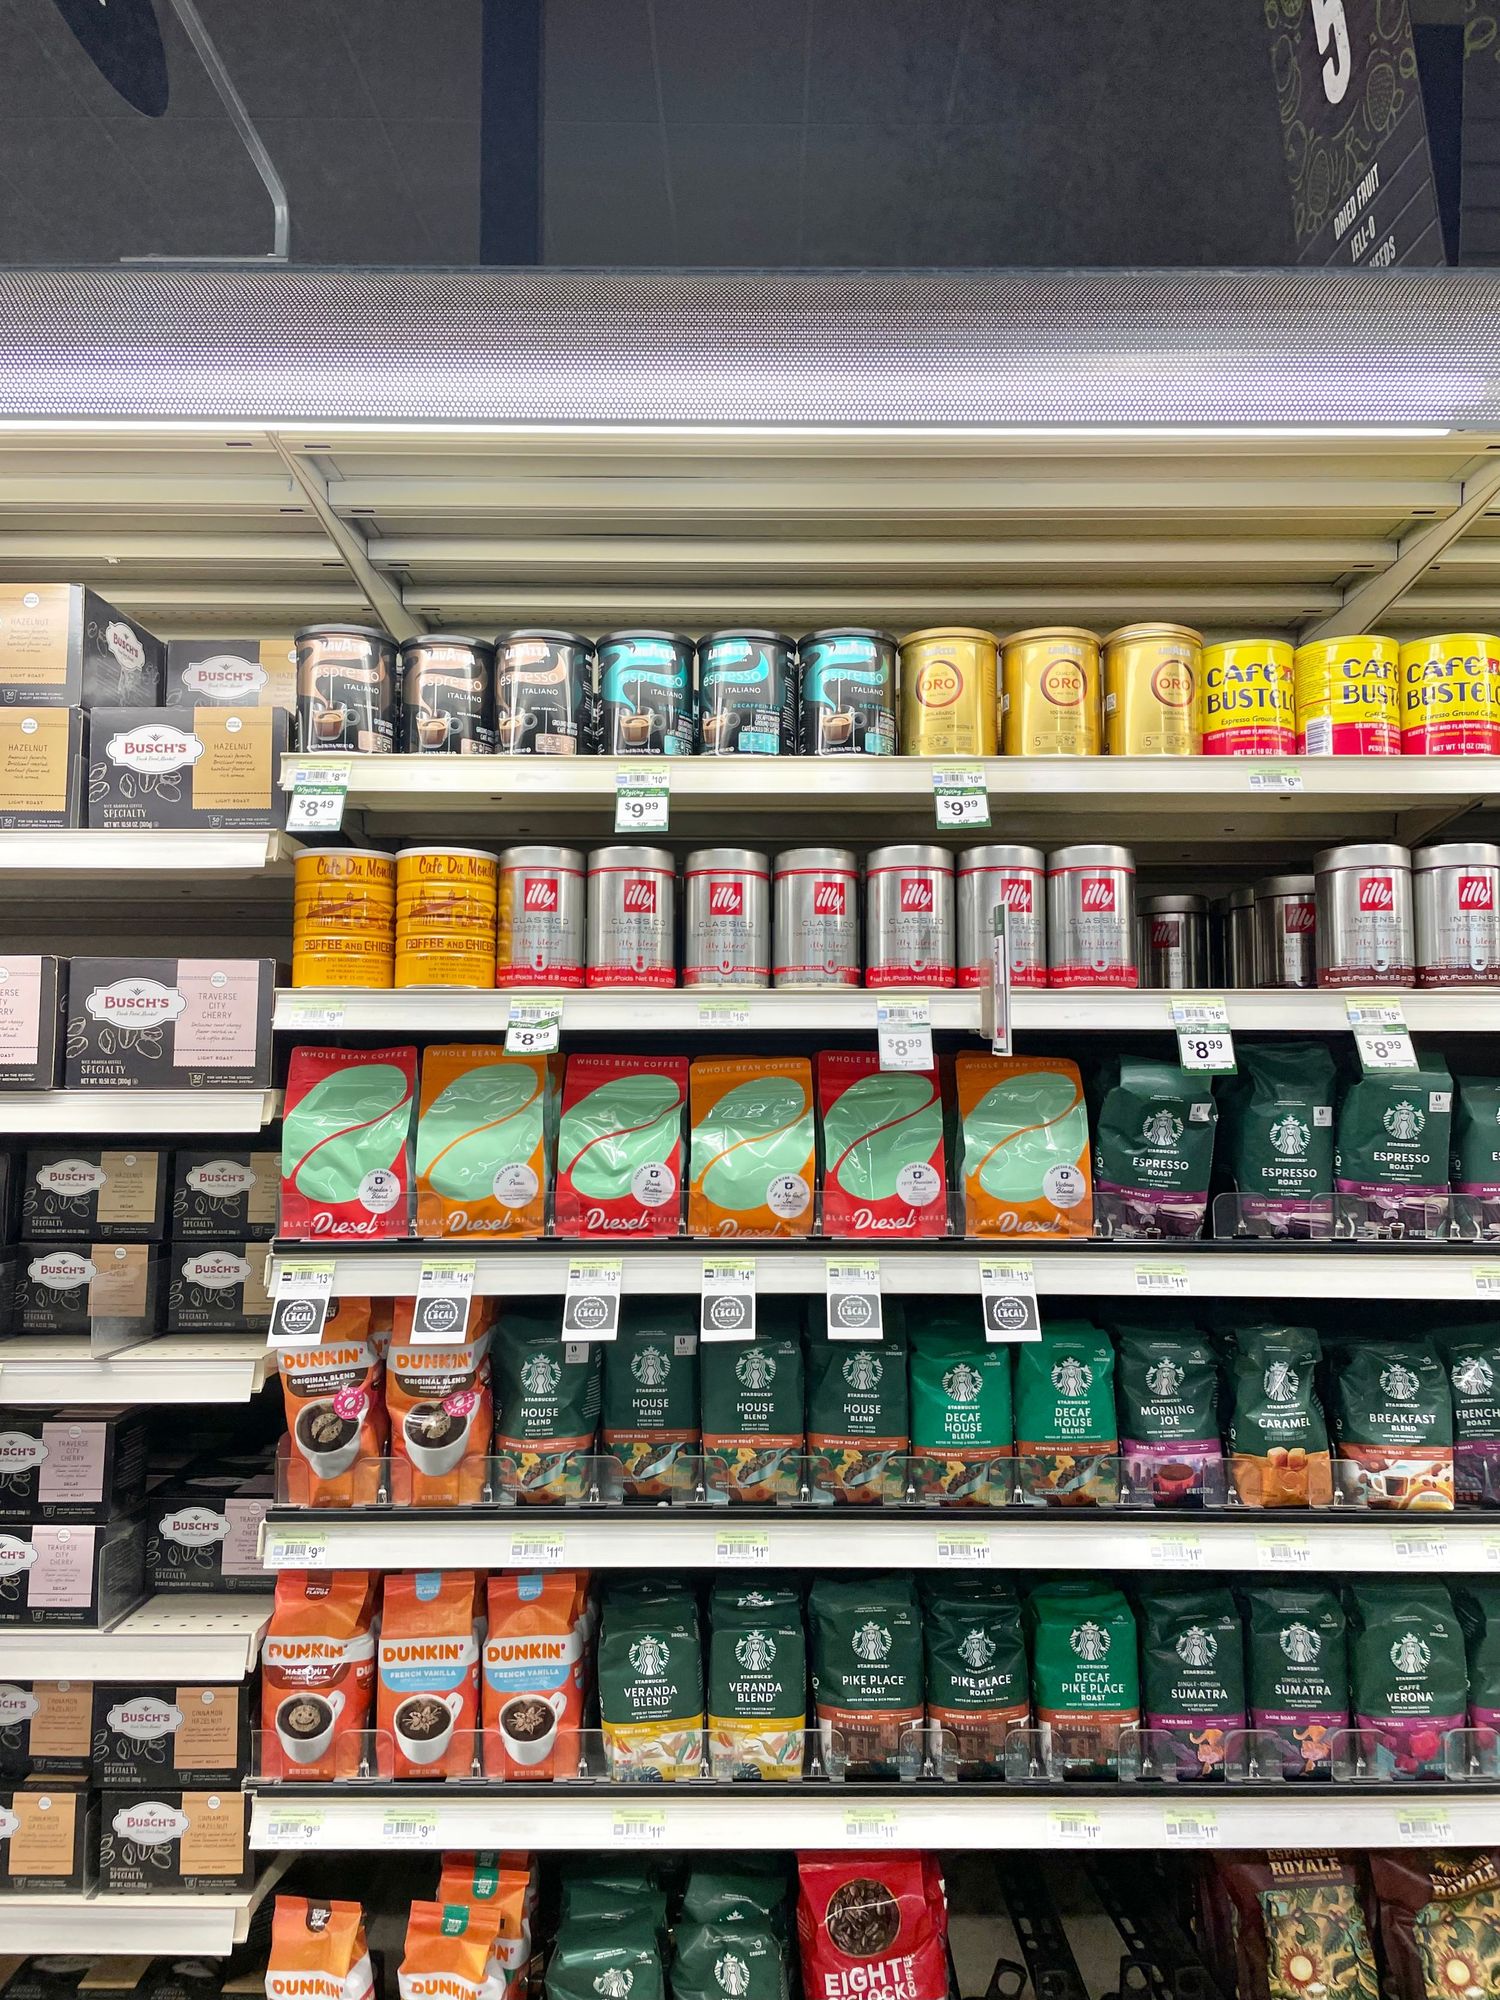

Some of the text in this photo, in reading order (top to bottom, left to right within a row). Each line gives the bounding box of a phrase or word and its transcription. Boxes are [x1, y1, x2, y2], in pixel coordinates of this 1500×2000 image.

[1311, 0, 1350, 104] 5
[1333, 162, 1380, 241] DRIED FRUIT
[112, 633, 139, 659] BUSCH'S
[198, 671, 254, 682] BUSCH'S
[312, 665, 379, 683] espresso
[500, 672, 558, 687] espresso
[418, 673, 482, 692] espresso
[922, 678, 956, 691] ORO
[1048, 677, 1082, 690] ORO
[1159, 677, 1190, 690] ORO
[343, 683, 380, 695] ITALIANO
[522, 688, 558, 696] ITALIANO
[650, 689, 683, 700] ITALIANO
[447, 692, 482, 703] ITALIANO
[1221, 717, 1250, 726] Espresso
[124, 742, 187, 754] BUSCH'S
[104, 809, 147, 818] SPECIALTY
[345, 857, 363, 876] Du
[446, 856, 465, 875] Du
[526, 883, 556, 907] illy
[625, 885, 656, 910] illy
[711, 887, 741, 912] illy
[816, 886, 844, 912] illy
[901, 884, 931, 908] illy
[1002, 884, 1031, 908] illy
[1083, 884, 1113, 908] illy
[1361, 881, 1393, 908] illy
[1461, 881, 1491, 908] illy
[512, 917, 569, 925] CLASSICO
[611, 918, 666, 926] CLASSICO
[698, 920, 754, 928] CLASSICO
[1287, 907, 1315, 931] illy
[1153, 925, 1178, 946] illy
[304, 938, 362, 952] COFFEE AND
[406, 938, 464, 950] COFFEE AND
[1330, 975, 1341, 983] Net
[1375, 974, 1388, 982] Net
[198, 992, 238, 1000] TRAVERSE
[104, 996, 169, 1009] BUSCH'S
[208, 1002, 226, 1010] CITY
[201, 1011, 232, 1019] CHERRY
[371, 1052, 408, 1060] COFFEE
[576, 1058, 610, 1066] WHOLE
[81, 1065, 126, 1074] SPECIALTY
[1132, 1157, 1189, 1170] ESPRESSO
[1373, 1152, 1430, 1164] ESPRESSO
[1148, 1169, 1173, 1177] ROAST
[1262, 1168, 1317, 1178] ESPRESSO
[1389, 1163, 1414, 1171] ROAST
[313, 1212, 378, 1234] Diesel
[449, 1211, 511, 1232] Diesel
[586, 1207, 649, 1230] Diesel
[853, 1208, 916, 1230] Diesel
[998, 1211, 1061, 1233] Diesel
[283, 1347, 364, 1370] DUNKIN'
[395, 1351, 473, 1369] DUNKIN'
[292, 1372, 356, 1385] ORIGINAL BLEND
[632, 1398, 669, 1408] HOUSE
[736, 1402, 775, 1412] HOUSE
[843, 1404, 881, 1414] HOUSE
[520, 1408, 559, 1418] HOUSE
[1055, 1407, 1091, 1417] DECAF
[1140, 1405, 1195, 1416] MORNING
[1455, 1409, 1500, 1420] FRENCH
[945, 1412, 981, 1422] DECAF
[1160, 1415, 1180, 1425] JOE
[1369, 1413, 1436, 1424] BREAKFAST
[944, 1423, 983, 1433] HOUSE
[1258, 1418, 1311, 1429] CARAMEL
[268, 1644, 348, 1659] DUNKIN'
[383, 1644, 464, 1663] DUNKIN'
[487, 1643, 566, 1662] DUNKIN'
[390, 1668, 456, 1678] FRENCH VANILLA
[1074, 1673, 1110, 1682] DECAF
[842, 1675, 904, 1686] PIKE PLACE
[951, 1674, 1011, 1688] PIKE PLACE
[624, 1685, 678, 1698] VERANDA
[729, 1683, 782, 1693] VERANDA
[1062, 1683, 1124, 1694] PIKE PLACE
[1171, 1688, 1228, 1699] SUMATRA
[1274, 1685, 1332, 1696] SUMATRA
[1386, 1693, 1431, 1703] VERONA
[1269, 1858, 1342, 1876] ROYALE
[1432, 1863, 1500, 1897] ROYALE
[824, 1957, 903, 1997] EIGHT
[272, 1979, 344, 2000] DUNKIN'
